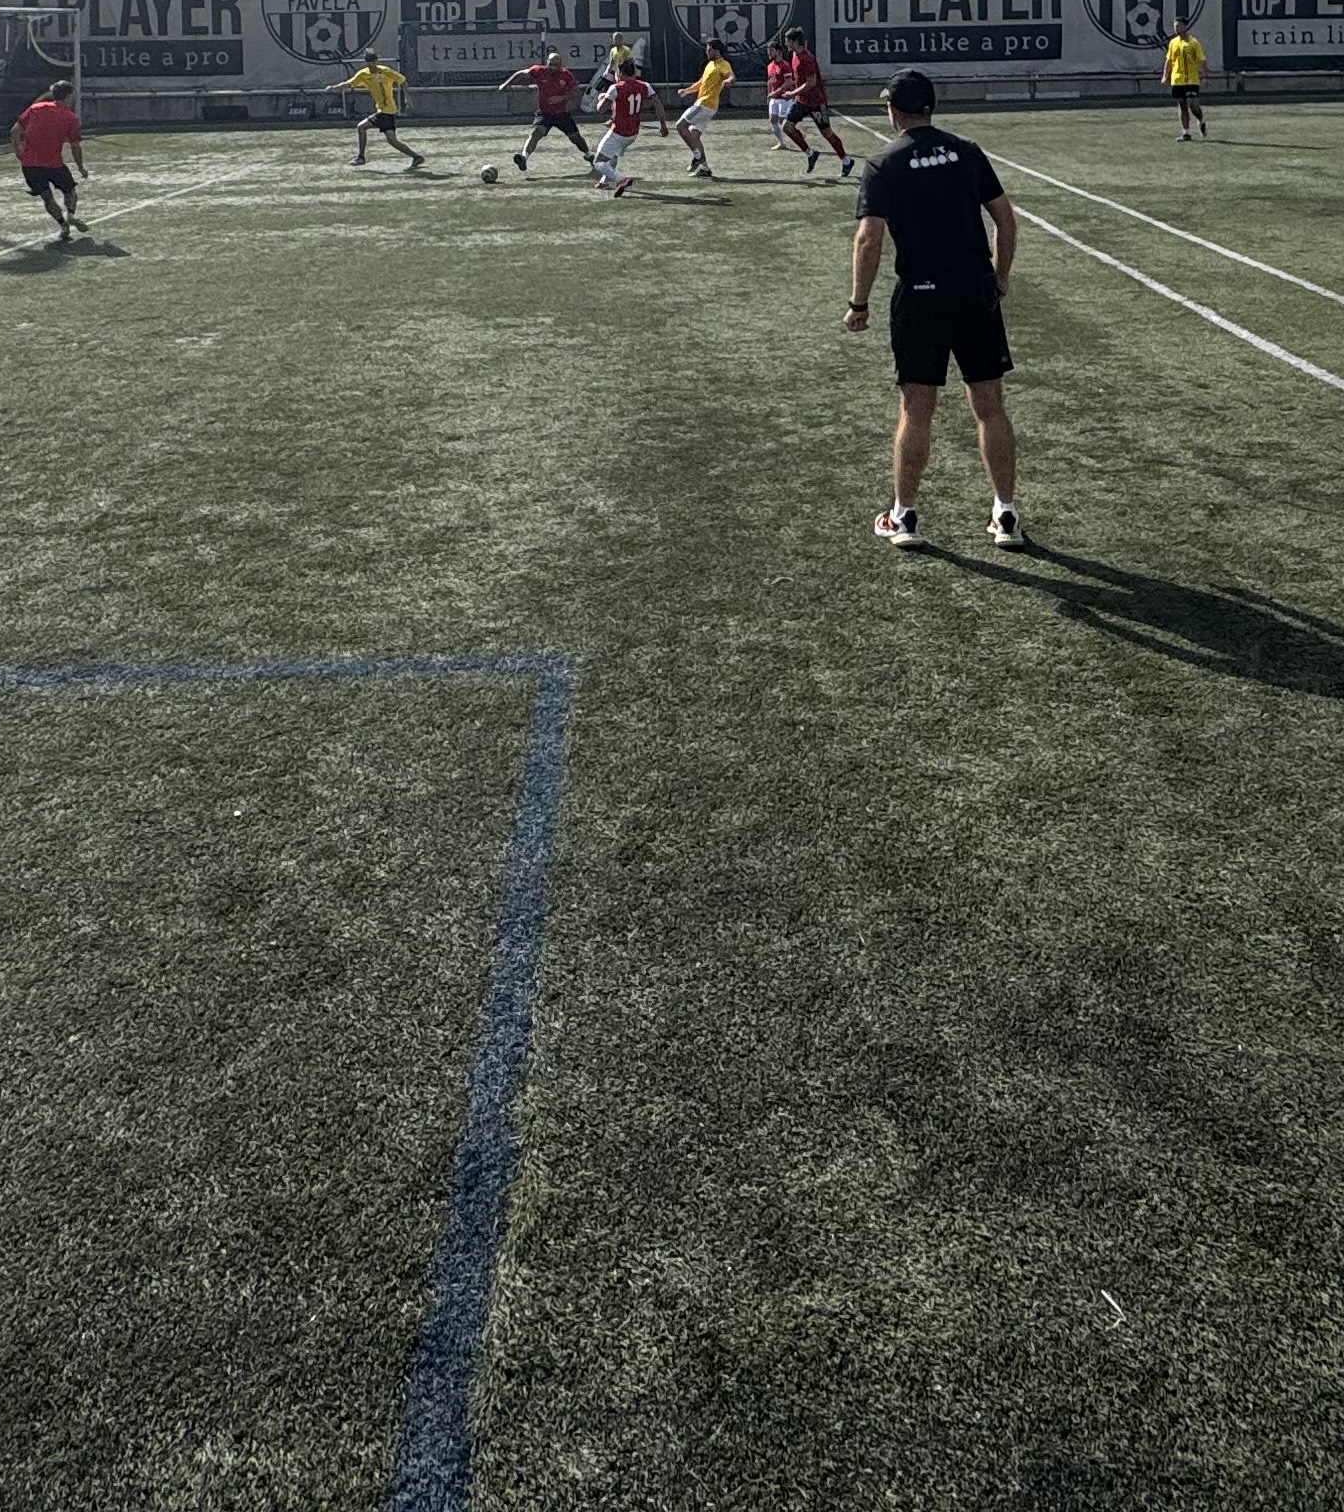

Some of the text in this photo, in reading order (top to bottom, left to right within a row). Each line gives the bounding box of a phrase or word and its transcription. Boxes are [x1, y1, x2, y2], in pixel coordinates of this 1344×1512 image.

[416, 2, 462, 31] TOP
[843, 33, 1050, 56] train like a pro
[1251, 27, 1315, 45] train
[99, 47, 152, 67] like
[162, 52, 175, 66] a
[185, 51, 230, 71] pro
[431, 42, 497, 61] train
[507, 40, 556, 60] like
[569, 44, 581, 58] a
[627, 92, 642, 115] 11
